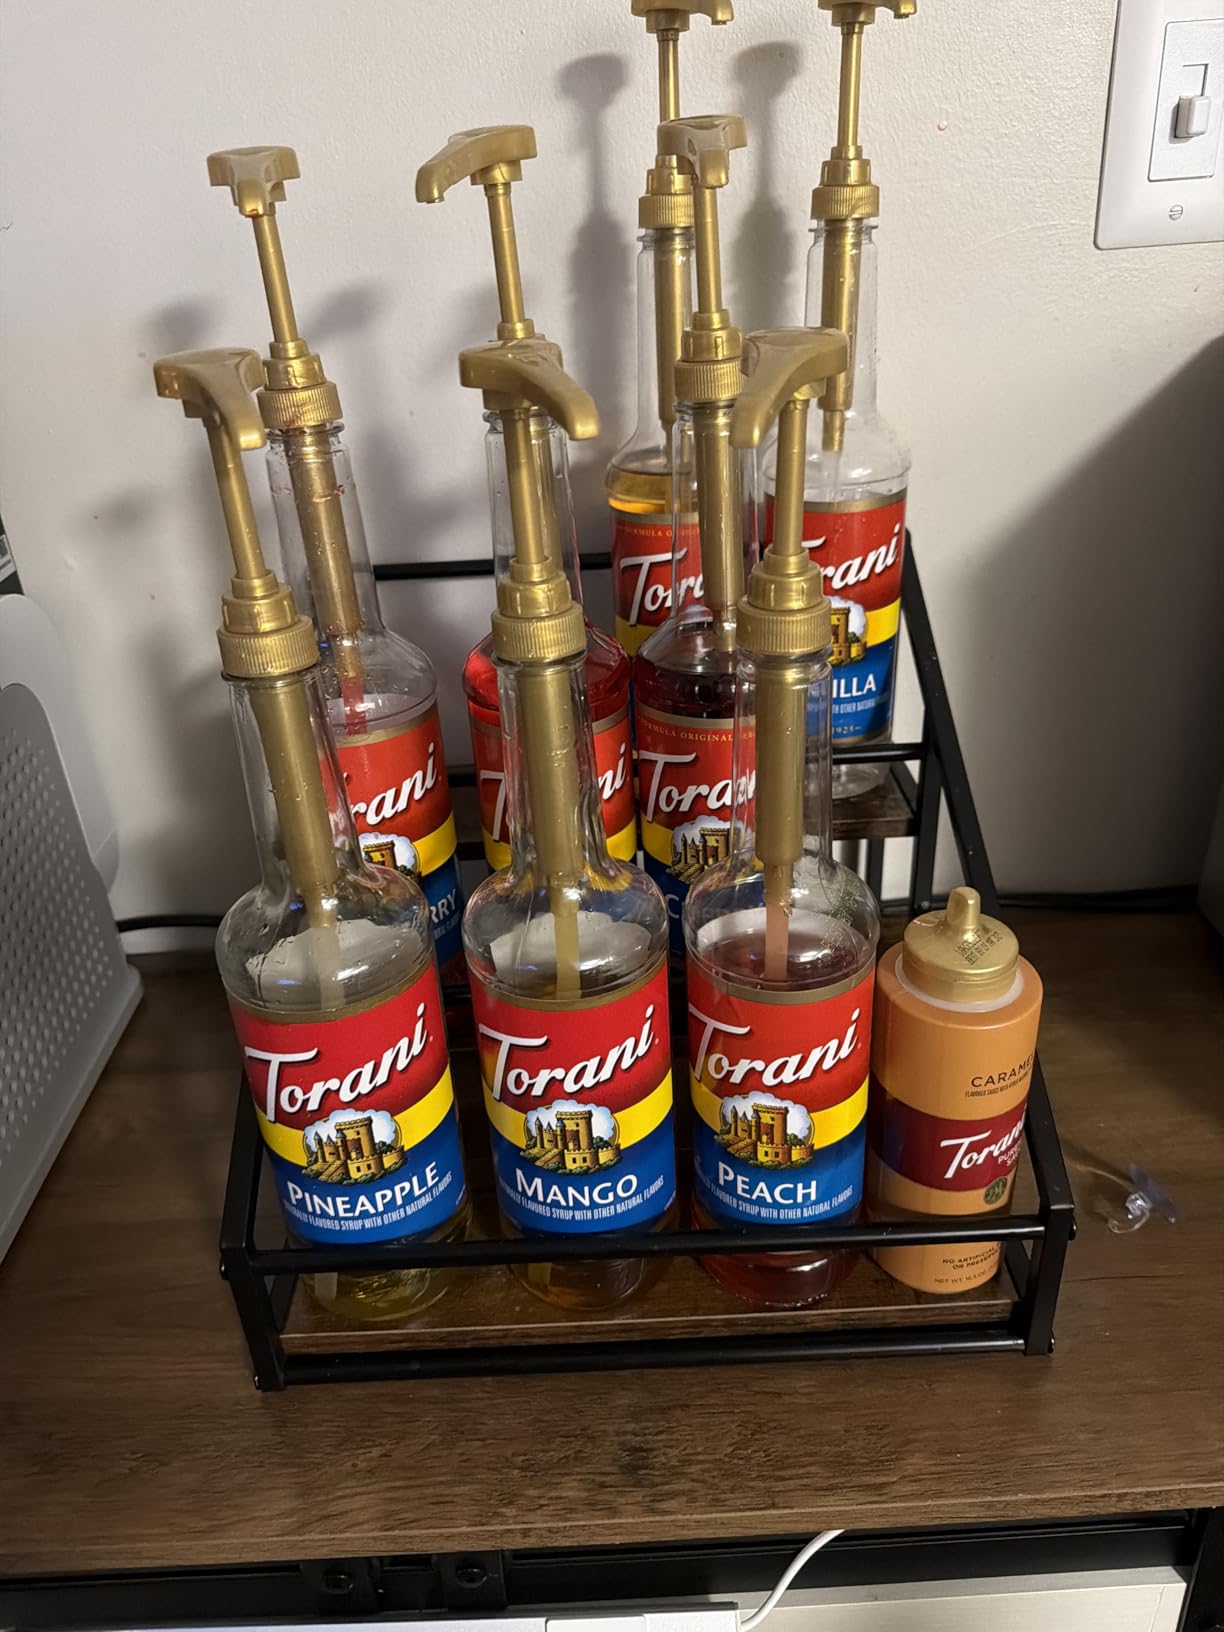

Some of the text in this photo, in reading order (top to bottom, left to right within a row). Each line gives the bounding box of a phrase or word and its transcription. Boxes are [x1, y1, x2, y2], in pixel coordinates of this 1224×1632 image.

[801, 523, 900, 590] rani
[832, 673, 877, 698] ILLA
[680, 731, 734, 742] ORIGINAL
[343, 742, 437, 826] rani
[244, 1002, 427, 1123] Torani
[478, 1004, 654, 1100] Torani
[689, 1003, 860, 1086] Torani
[287, 1161, 440, 1217] PINEAPPLE
[515, 1167, 638, 1207] MANGO
[718, 1161, 817, 1204] PEACH
[341, 1219, 364, 1231] SYRUP
[364, 1216, 383, 1229] WITH
[383, 1210, 405, 1225] OTHER
[406, 1196, 434, 1216] NATURAL
[551, 1208, 574, 1221] SYRUP
[574, 1208, 593, 1221] WITH
[593, 1205, 615, 1219] OTHER
[616, 1195, 643, 1214] NATURAL
[738, 1200, 760, 1216] SYRUP
[760, 1207, 778, 1219] WITH
[779, 1207, 801, 1219] OTHER
[802, 1200, 831, 1217] NATURAL
